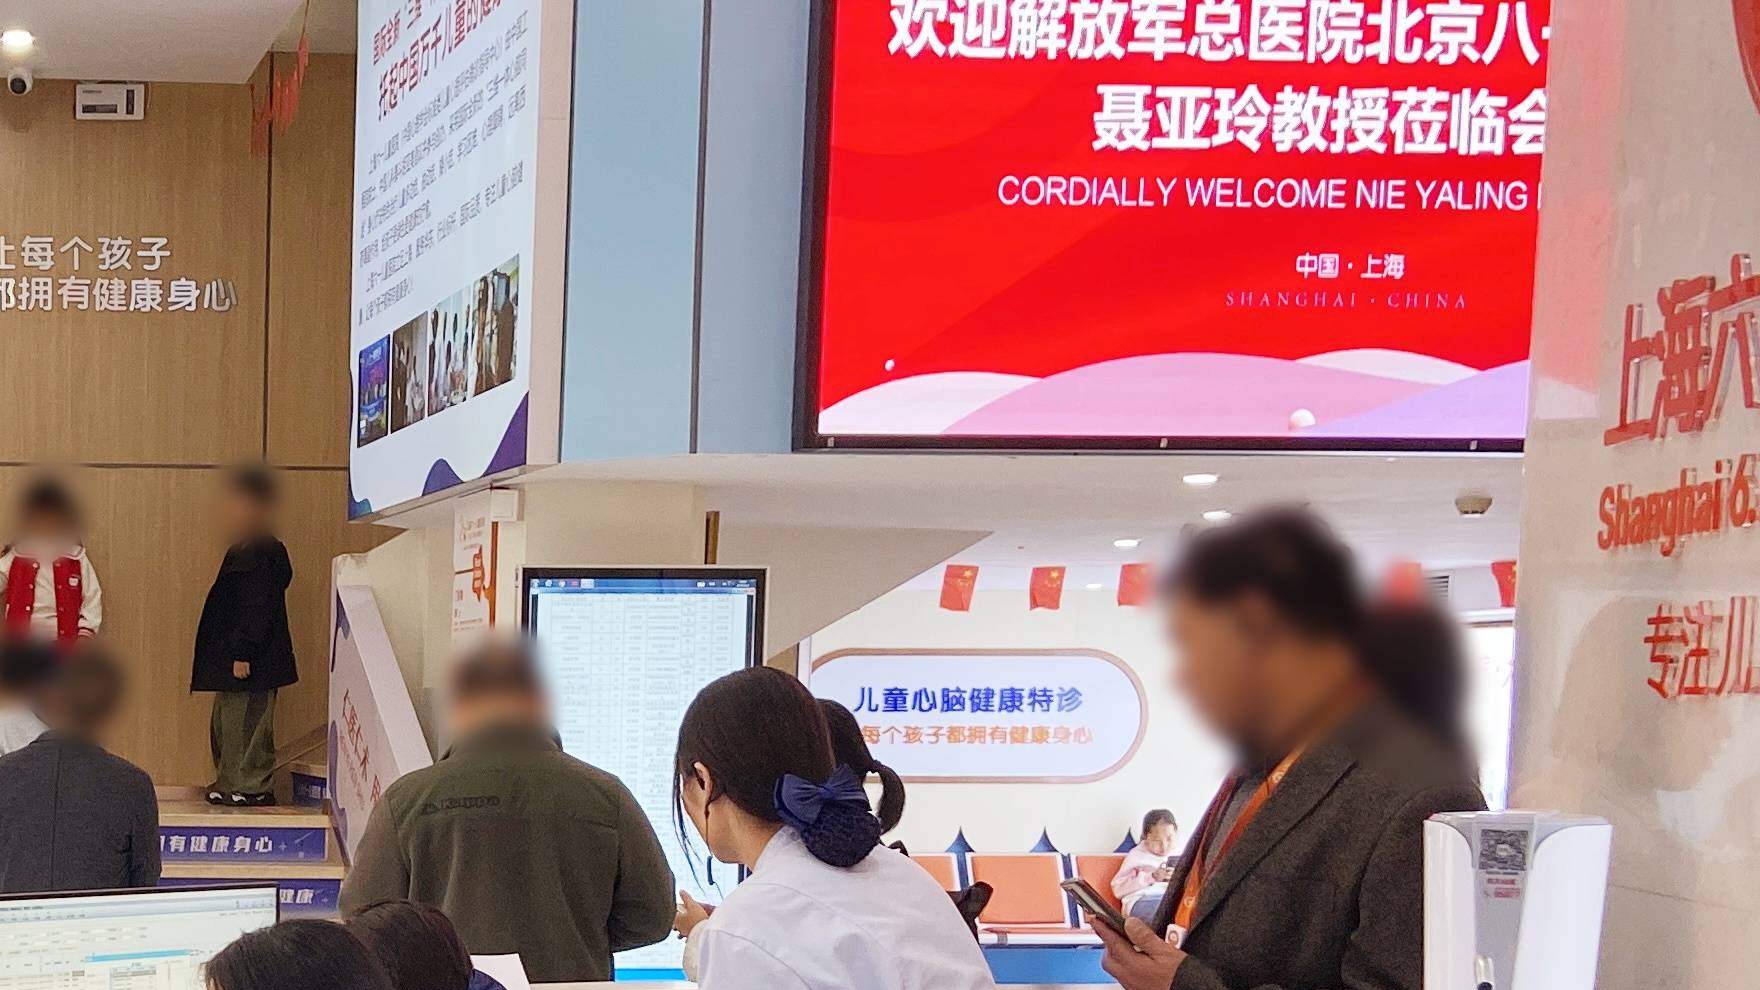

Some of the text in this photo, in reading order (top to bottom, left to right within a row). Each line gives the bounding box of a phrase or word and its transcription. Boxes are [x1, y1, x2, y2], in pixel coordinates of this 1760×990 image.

[888, 0, 1552, 65] 欢迎解放军总医院北京八
[1092, 83, 1547, 156] 聂亚玲教授莅临会
[997, 175, 1529, 211] CORDIALLY WELCOME NIE YALING
[1225, 291, 1468, 310] SHANGHAI CHINA
[1598, 454, 1760, 557] Shanghai 6.
[853, 685, 1084, 714] 儿童心脑健康特诊
[160, 835, 274, 854] 有健康身心
